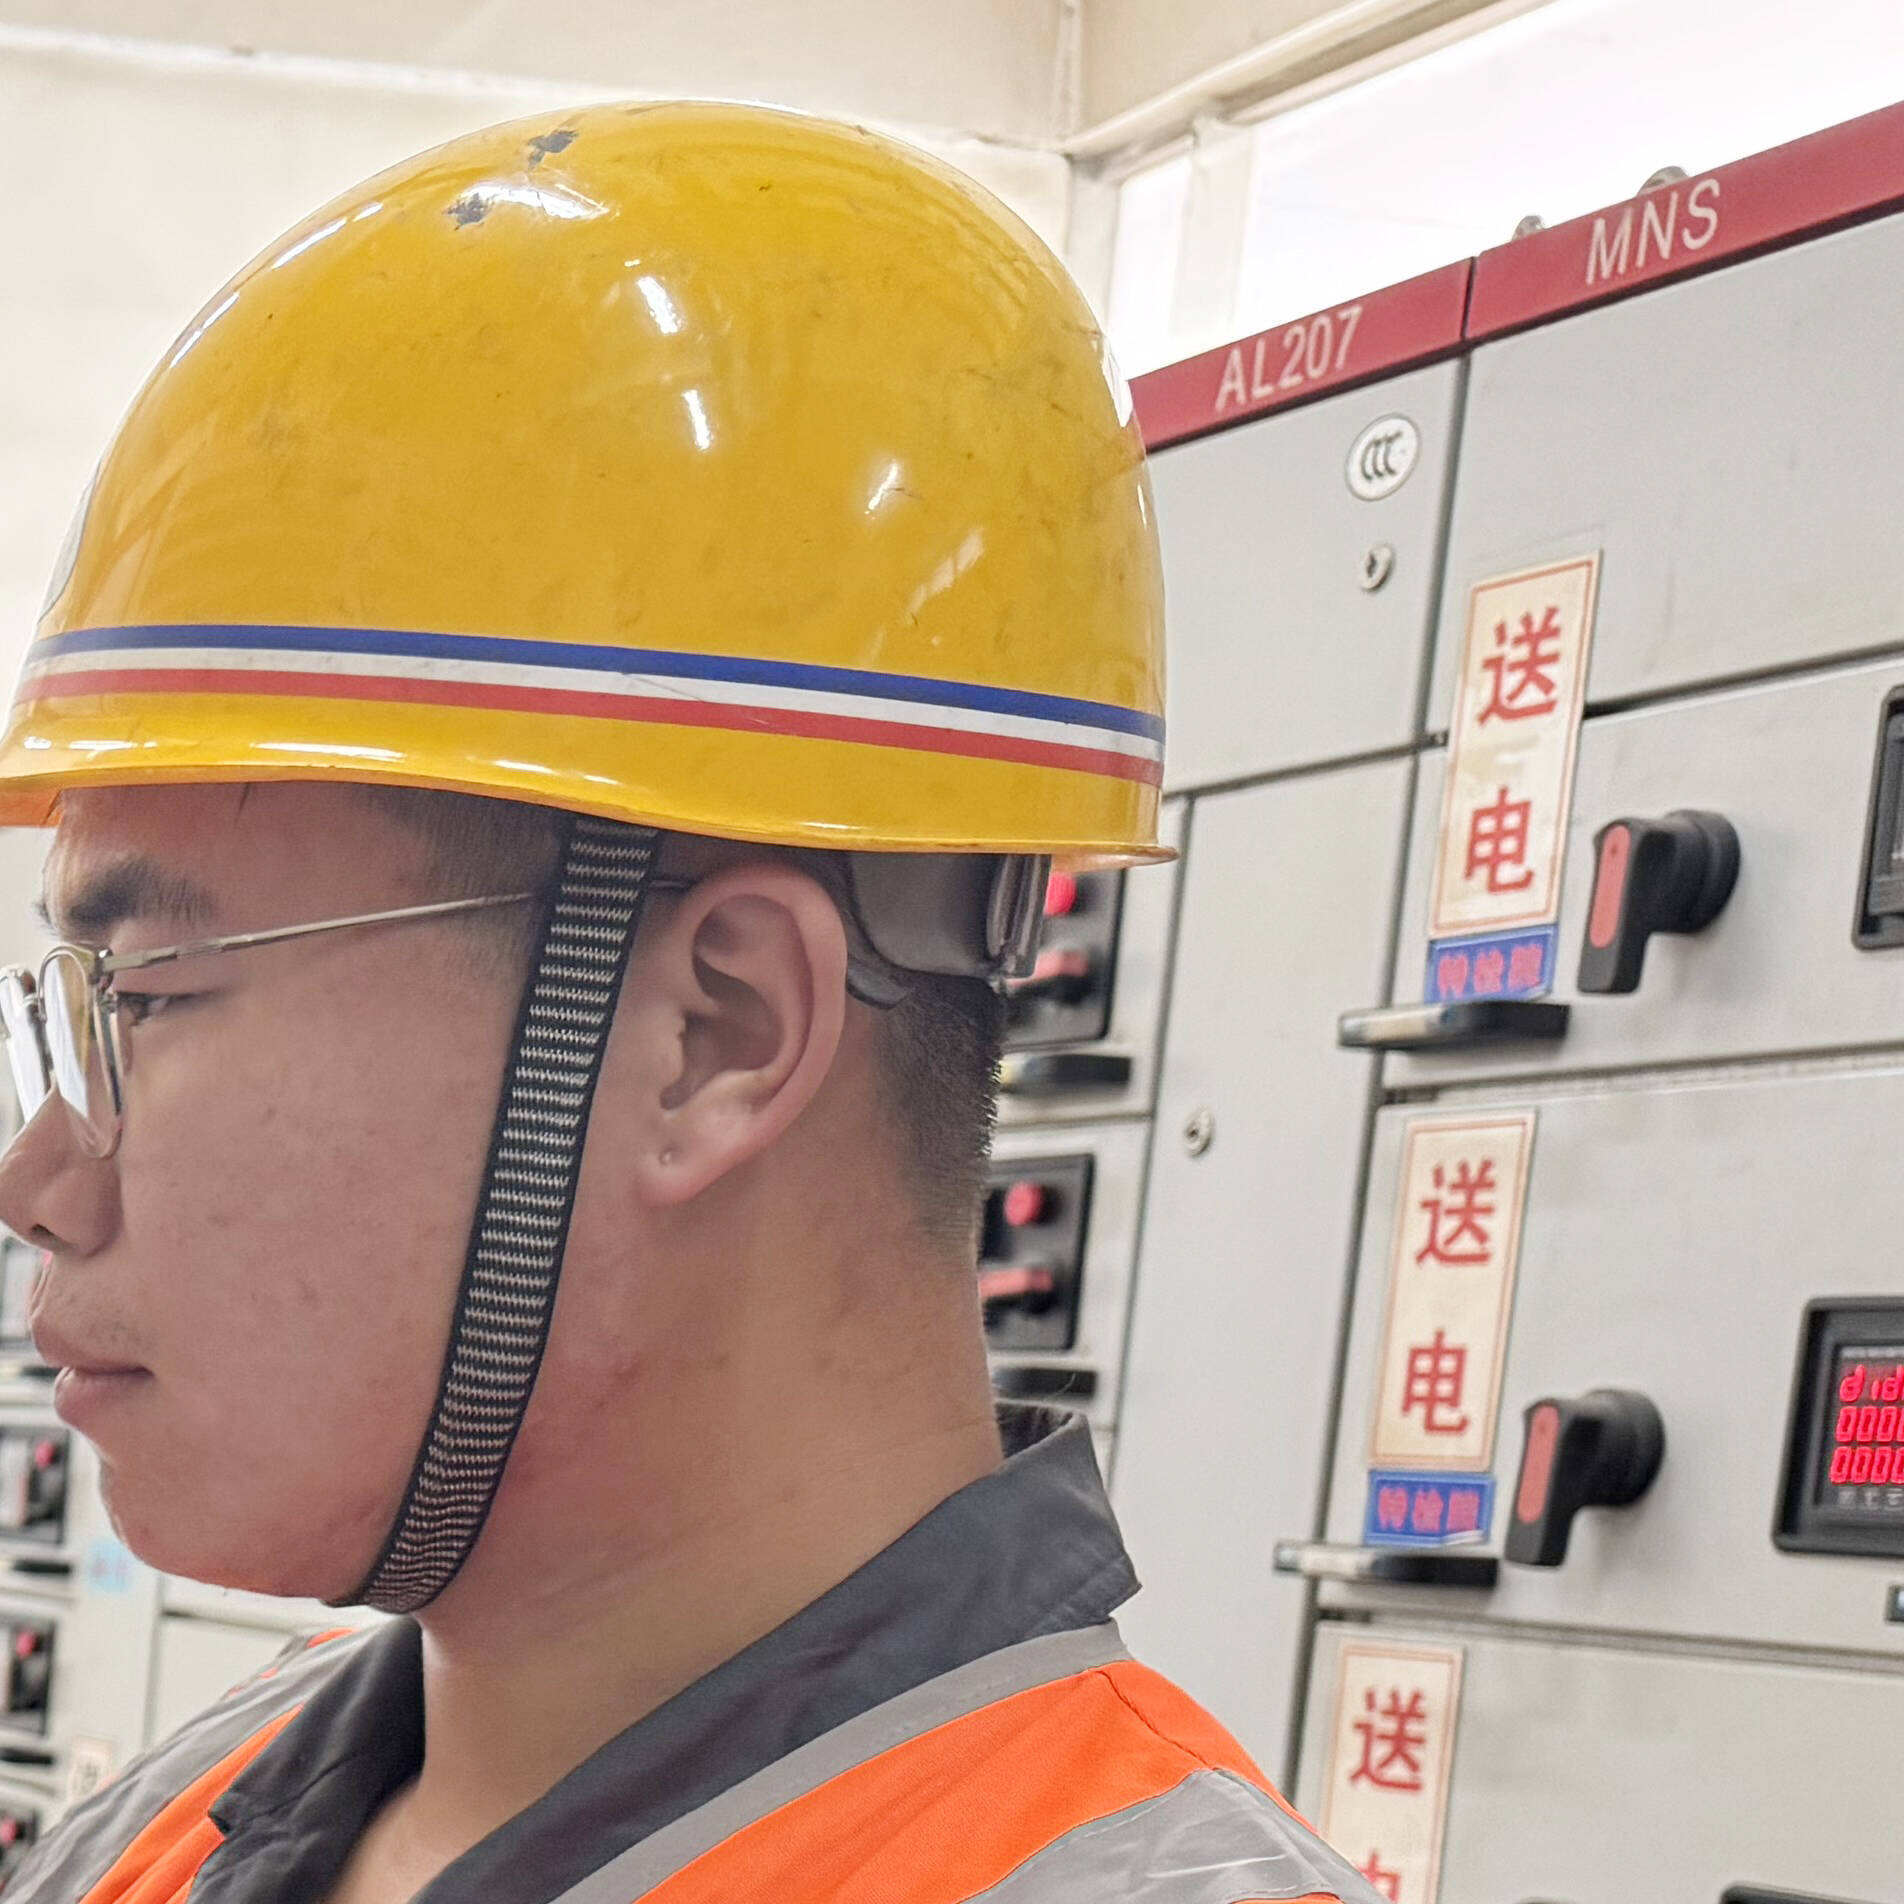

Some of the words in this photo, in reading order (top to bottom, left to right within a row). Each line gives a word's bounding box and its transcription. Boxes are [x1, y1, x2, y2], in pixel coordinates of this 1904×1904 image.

[1585, 177, 1722, 286] MNS
[1215, 305, 1364, 413] AL207
[1463, 605, 1562, 895] 送电
[1402, 1158, 1496, 1436] 送电
